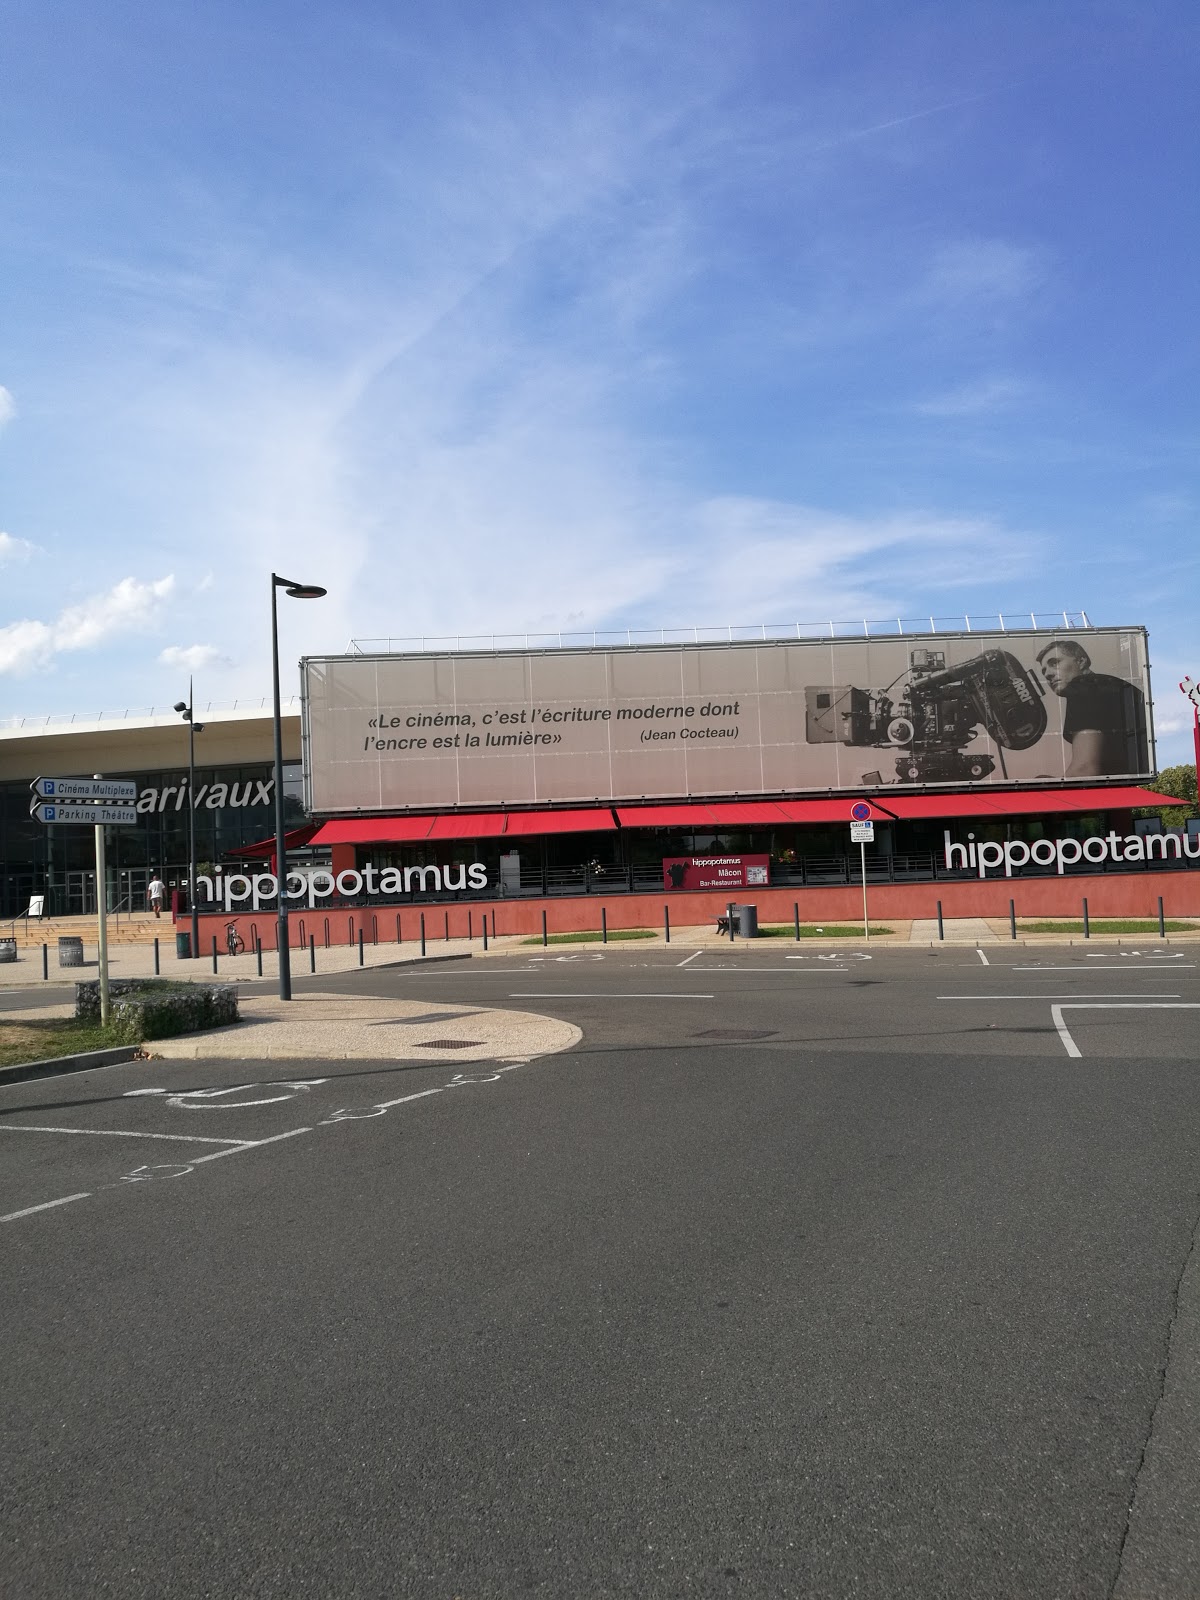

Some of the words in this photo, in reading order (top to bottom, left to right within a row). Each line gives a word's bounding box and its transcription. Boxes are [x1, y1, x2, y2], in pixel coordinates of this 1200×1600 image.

[368, 714, 400, 728] «Le
[405, 712, 476, 728] cinéma,
[482, 710, 526, 725] c’est
[530, 707, 611, 723] l’écriture
[616, 705, 695, 720] moderne
[699, 702, 739, 717] dont
[364, 736, 427, 751] l’encre
[432, 734, 460, 748] est
[464, 733, 480, 747] la
[485, 731, 562, 747] lumière»
[639, 729, 676, 743] (Jean
[679, 726, 739, 740] Cocteau)
[45, 782, 54, 794] P
[58, 783, 89, 794] Cinéma
[92, 784, 134, 797] Multiplexe
[46, 808, 55, 820] P
[58, 809, 96, 822] Parking
[101, 810, 134, 820] Théâtre
[692, 858, 741, 867] hippopotamus
[718, 869, 742, 877] Mâcon
[699, 879, 742, 887] Bar-Restaurant
